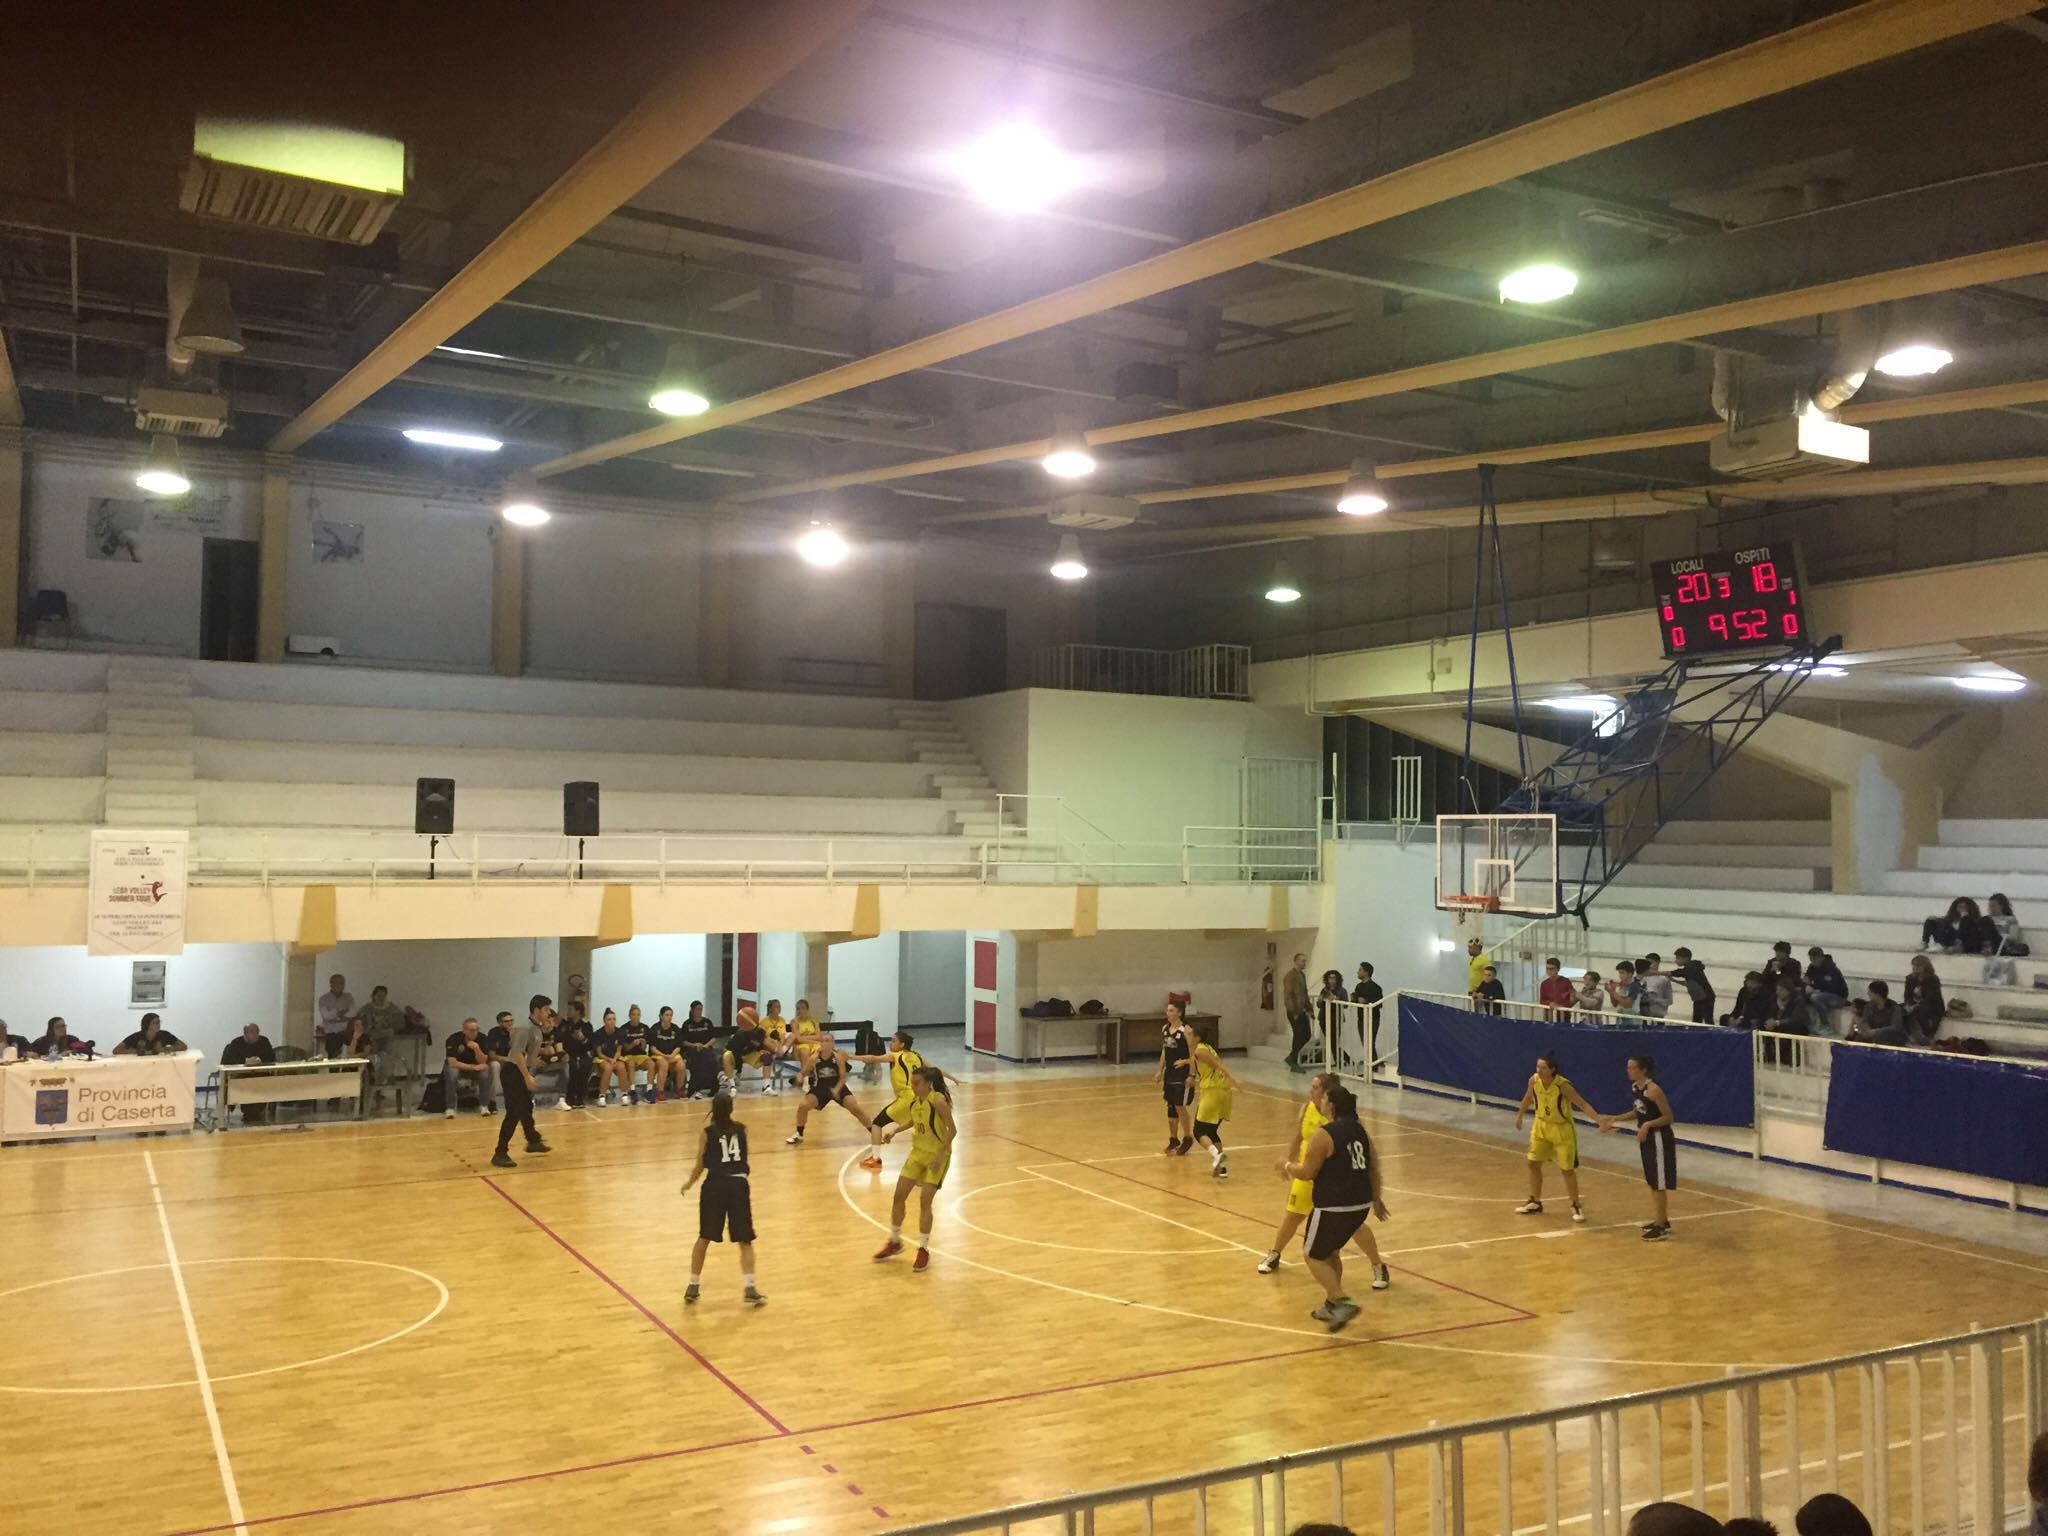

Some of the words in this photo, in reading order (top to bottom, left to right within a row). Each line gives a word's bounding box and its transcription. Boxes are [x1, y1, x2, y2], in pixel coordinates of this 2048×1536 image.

[1735, 548, 1770, 564] OSPITI
[1671, 559, 1703, 574] LOCALI
[1752, 563, 1777, 592] 18
[1678, 573, 1711, 603] 20
[1717, 578, 1730, 598] 3
[1782, 614, 1798, 634] 0
[1671, 626, 1686, 647] 0
[78, 1085, 167, 1103] Provincia
[77, 1107, 95, 1123] di
[101, 1103, 176, 1121] Caserta
[719, 1134, 741, 1163] 14
[1347, 1140, 1366, 1170] 18
